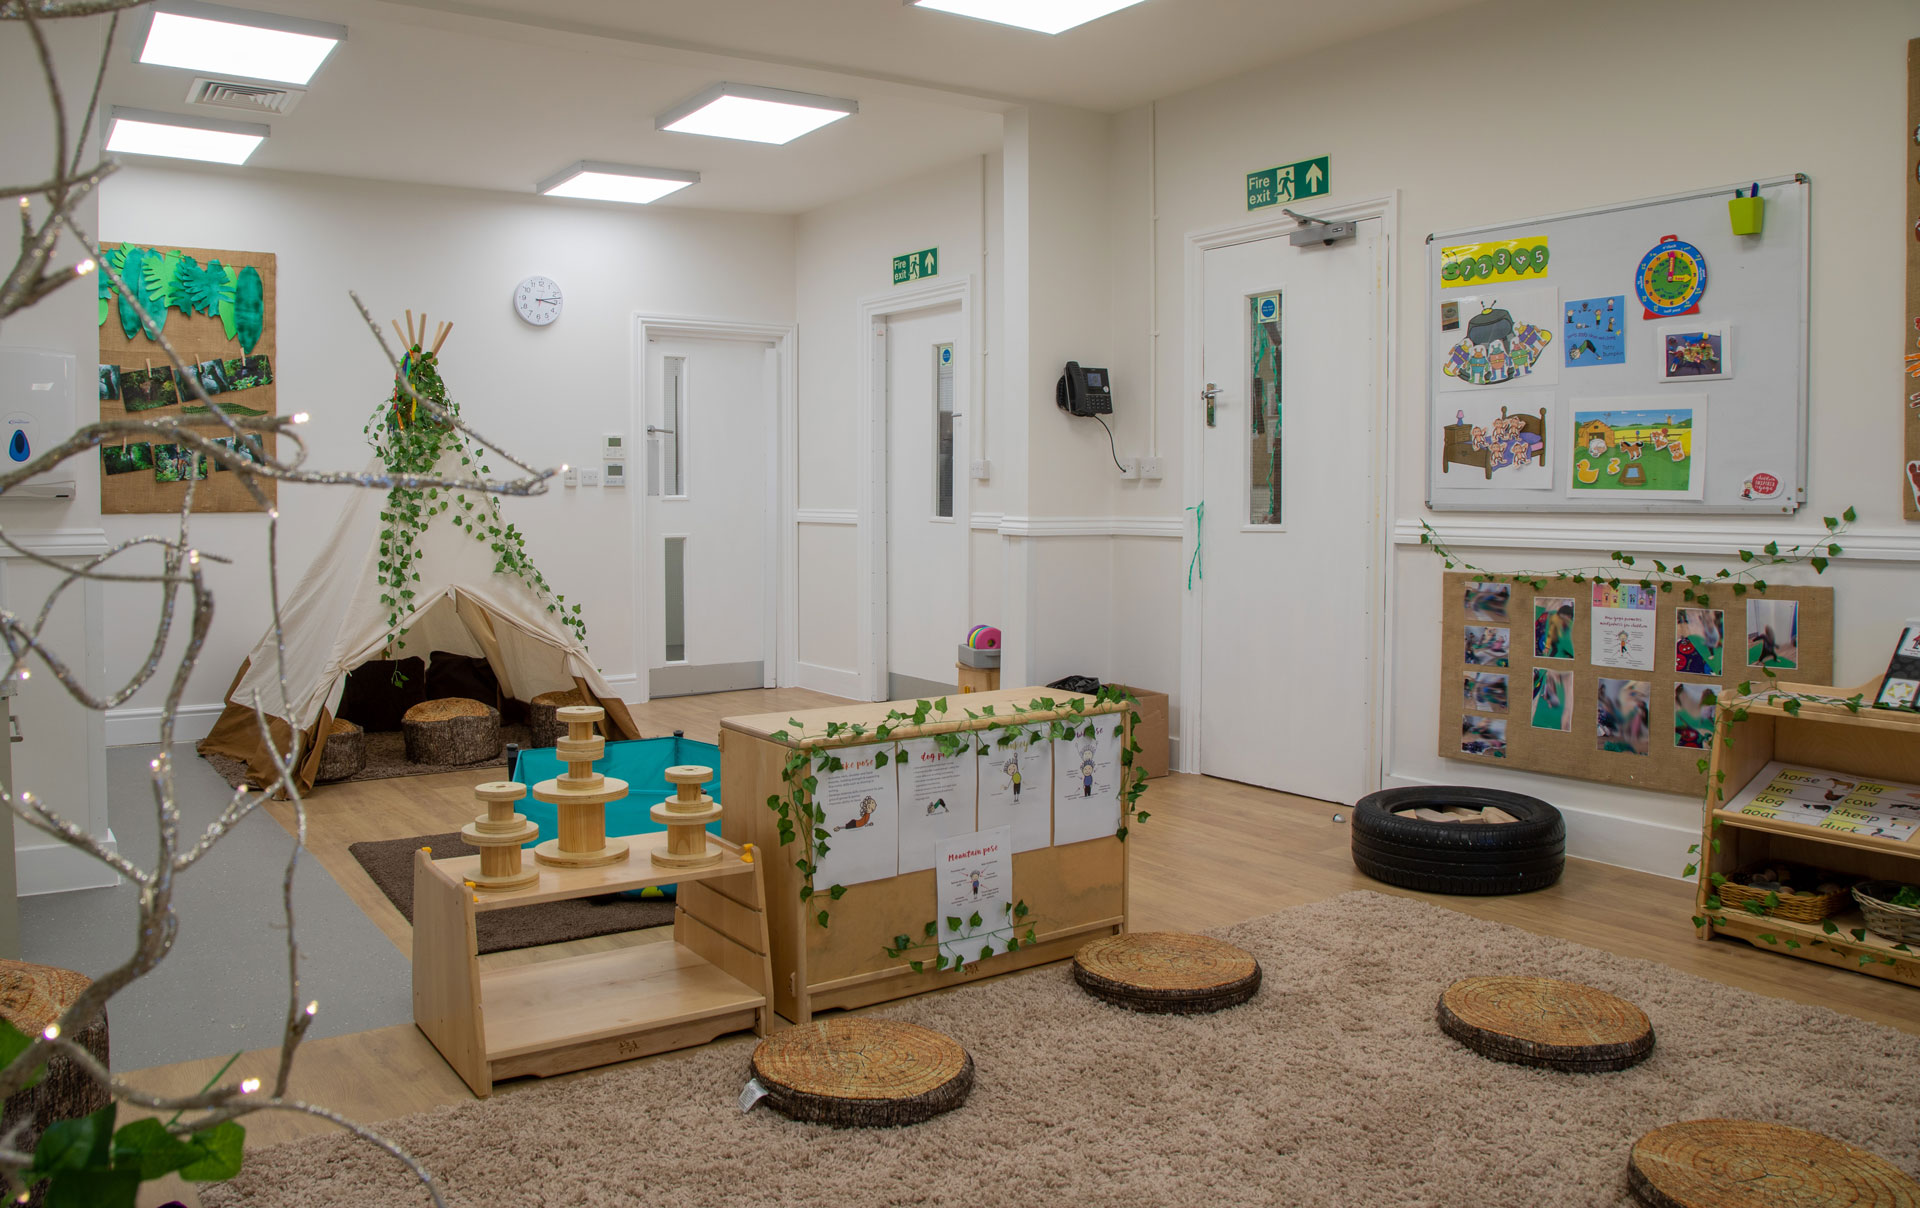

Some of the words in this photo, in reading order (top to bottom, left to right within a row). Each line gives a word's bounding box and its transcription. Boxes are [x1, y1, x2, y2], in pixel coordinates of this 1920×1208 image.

[1249, 176, 1270, 190] Fire
[1249, 189, 1271, 205] exit
[894, 260, 906, 270] Fire
[1464, 265, 1470, 275] 1
[1479, 263, 1488, 275] 2
[1497, 253, 1505, 265] 3
[1515, 255, 1526, 265] 4
[1536, 250, 1544, 263] 5
[895, 270, 906, 280] exit
[921, 752, 935, 763] dog
[856, 759, 874, 770] pose
[1778, 771, 1820, 784] horse
[1766, 784, 1793, 794] hen
[1856, 783, 1883, 794] pig
[1755, 796, 1784, 807] dog
[1844, 797, 1878, 808] cow
[1833, 808, 1880, 823] sheep
[1820, 822, 1860, 834] duck
[948, 849, 982, 862] Mountain
[983, 844, 998, 856] pose
